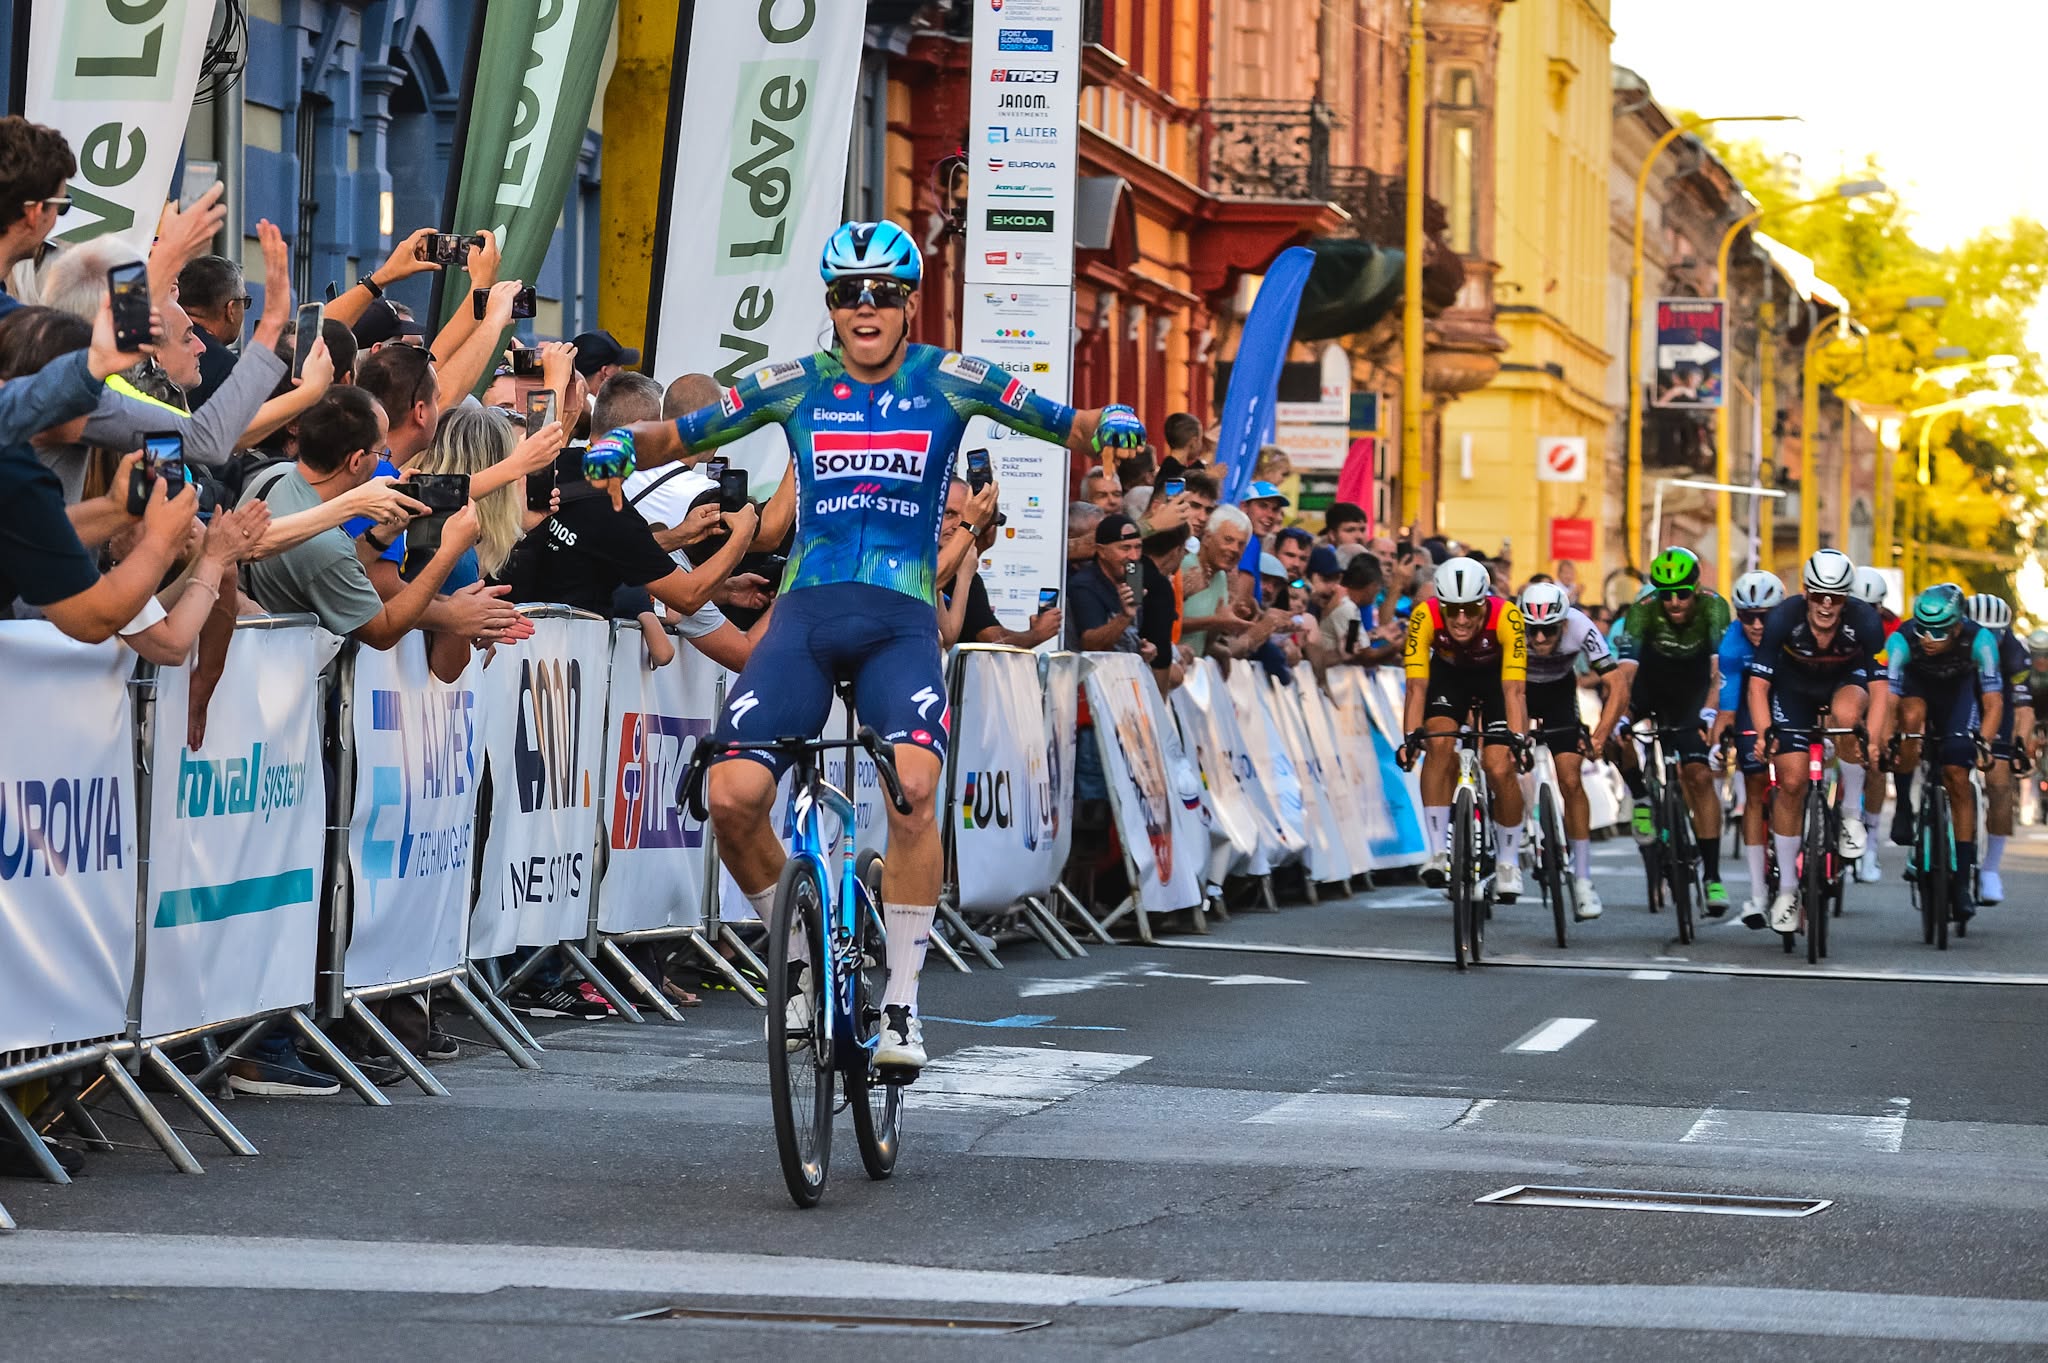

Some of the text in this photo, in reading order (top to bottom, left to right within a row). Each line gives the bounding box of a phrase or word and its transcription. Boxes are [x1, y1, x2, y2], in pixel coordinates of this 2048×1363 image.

[1008, 70, 1056, 82] TIPOS
[1015, 127, 1057, 138] ALITER
[1008, 161, 1056, 169] EUROVIA
[997, 361, 1030, 373] dácia
[813, 408, 864, 423] Ekopak
[815, 453, 922, 477] SOUDAL
[262, 752, 306, 824] system
[974, 769, 1013, 830] UCI
